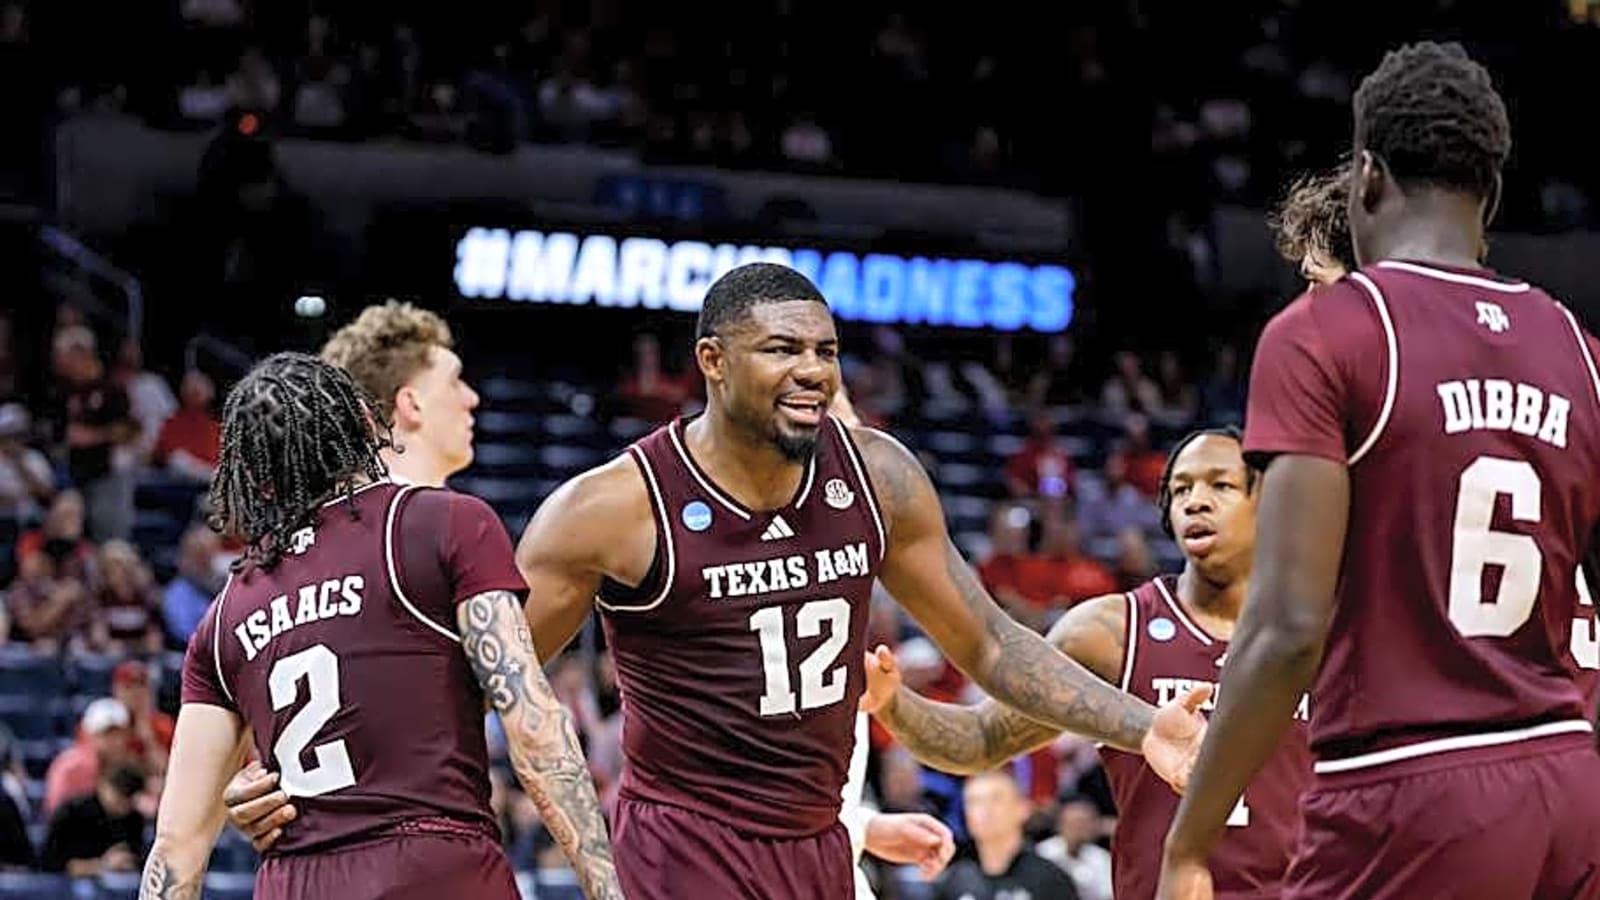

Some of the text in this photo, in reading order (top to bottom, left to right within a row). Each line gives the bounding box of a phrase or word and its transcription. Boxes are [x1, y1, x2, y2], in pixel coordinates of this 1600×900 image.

[1437, 378, 1571, 449] DIBBA
[702, 542, 870, 598] TEXAS A&M
[1448, 456, 1542, 638] 6
[235, 575, 364, 661] ISAACS
[750, 597, 851, 717] 12
[268, 644, 357, 799] 2
